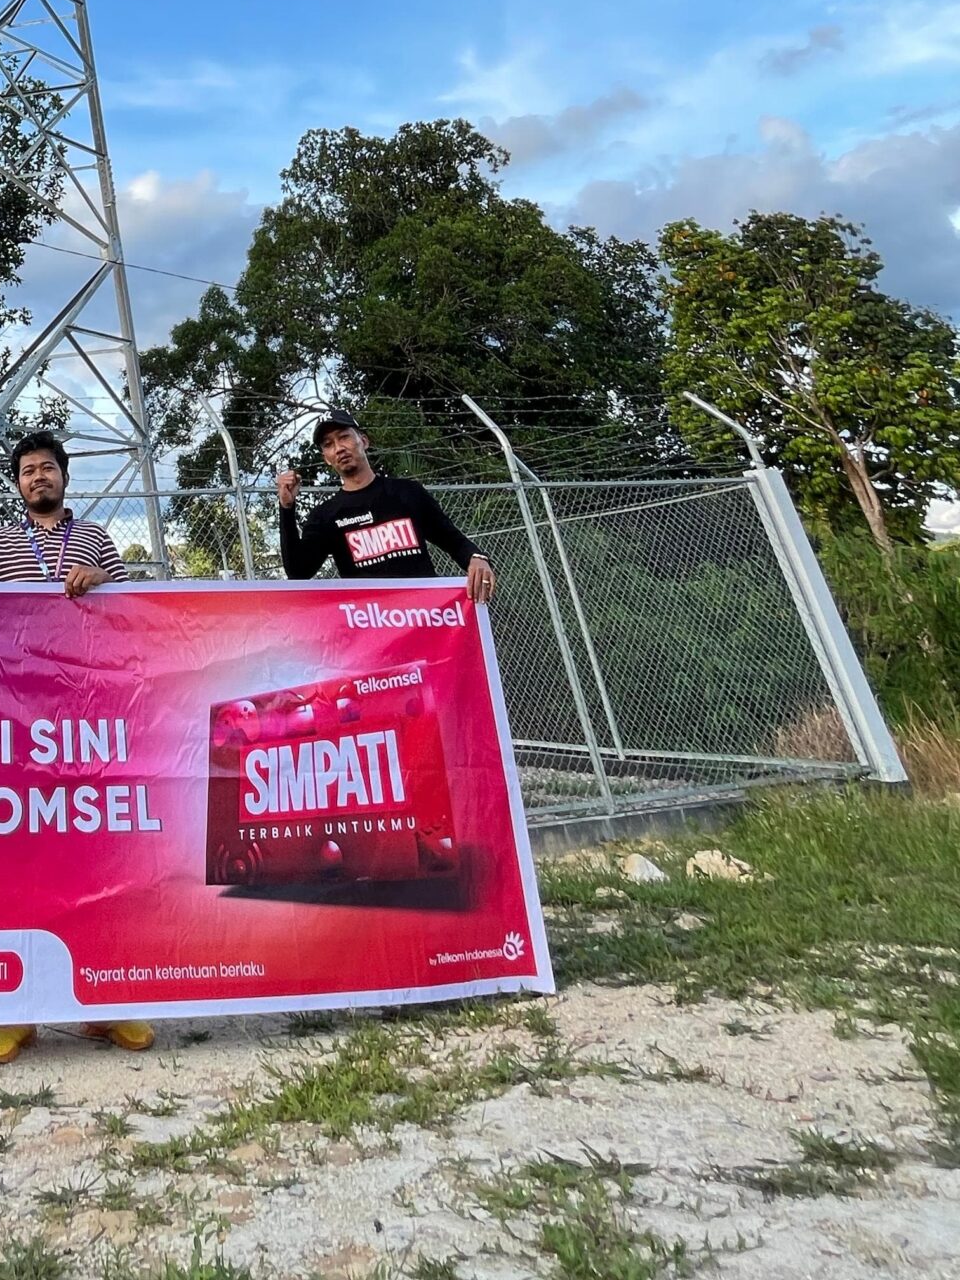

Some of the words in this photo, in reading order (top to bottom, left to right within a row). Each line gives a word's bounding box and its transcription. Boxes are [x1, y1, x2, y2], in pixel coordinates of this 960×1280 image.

[335, 511, 373, 527] Telkomsel
[348, 518, 417, 559] SIMPATI
[339, 601, 466, 629] Telkomsel
[353, 668, 424, 696] Telkomsel
[29, 718, 128, 764] SINI
[243, 729, 406, 816] SIMPATI
[239, 824, 313, 841] TERBAIK
[325, 816, 417, 836] UNTUKMU
[436, 952, 465, 964] Telkom
[465, 947, 503, 961] Indonesia
[128, 965, 153, 982] dan
[155, 963, 218, 981] ketentuan
[220, 961, 265, 978] berlaku
